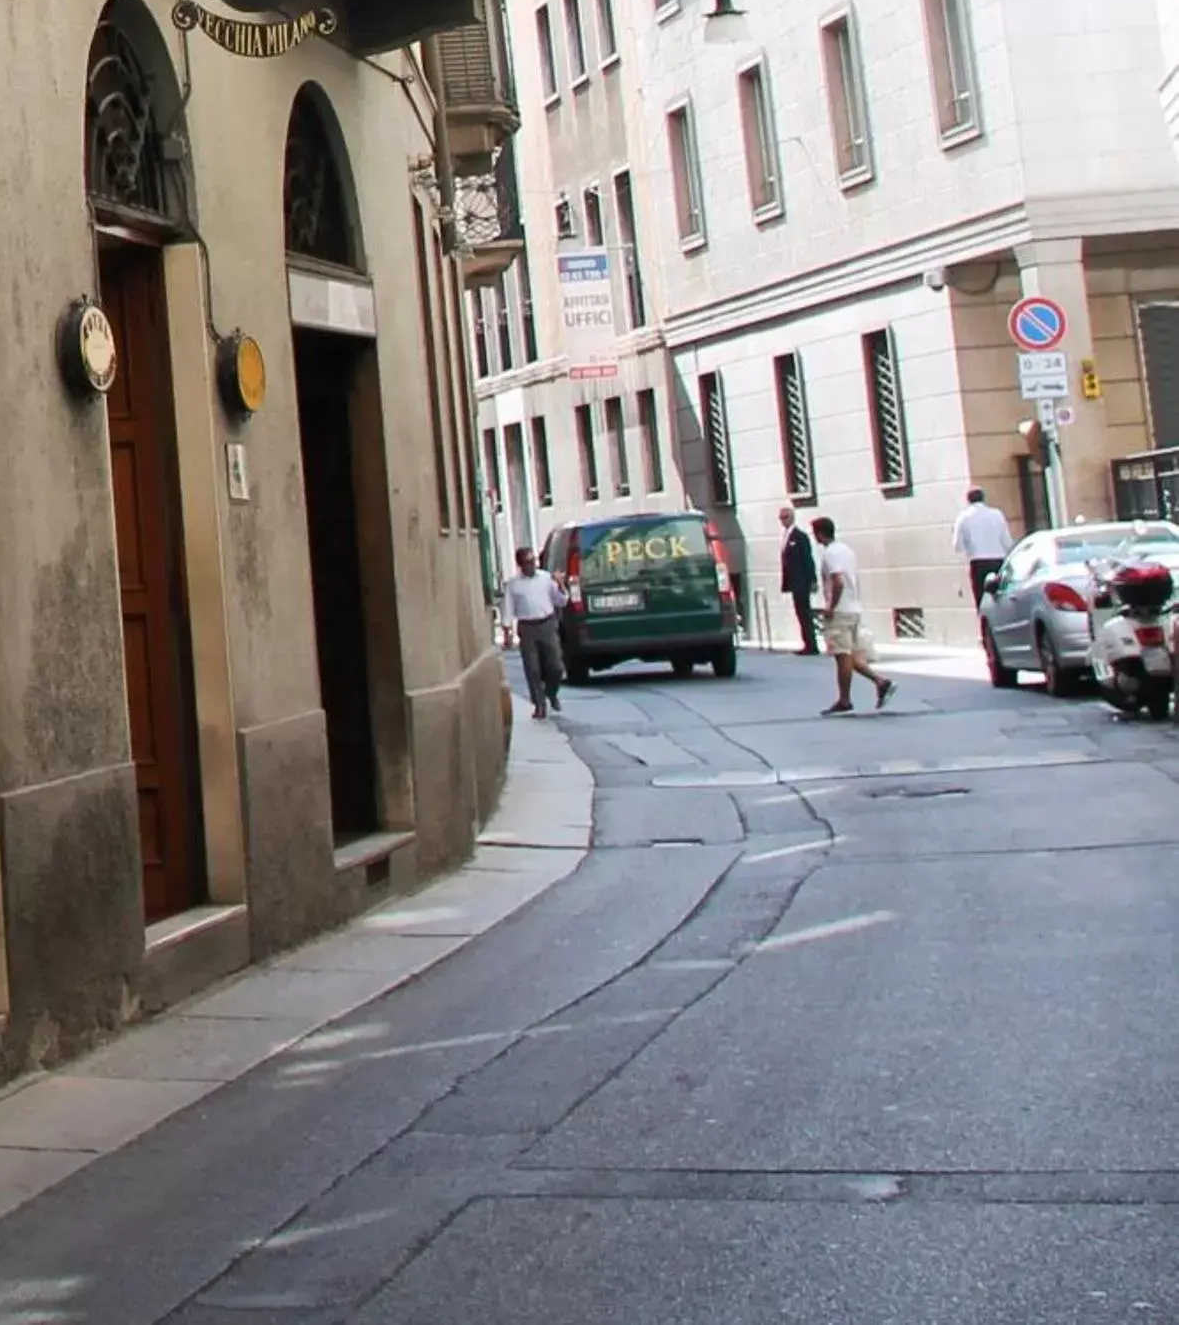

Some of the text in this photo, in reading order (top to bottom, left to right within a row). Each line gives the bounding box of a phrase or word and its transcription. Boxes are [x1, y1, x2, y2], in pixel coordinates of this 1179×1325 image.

[197, 5, 316, 56] VECCHIA MILANO
[564, 310, 612, 327] UFFICI
[605, 536, 690, 564] PECK
